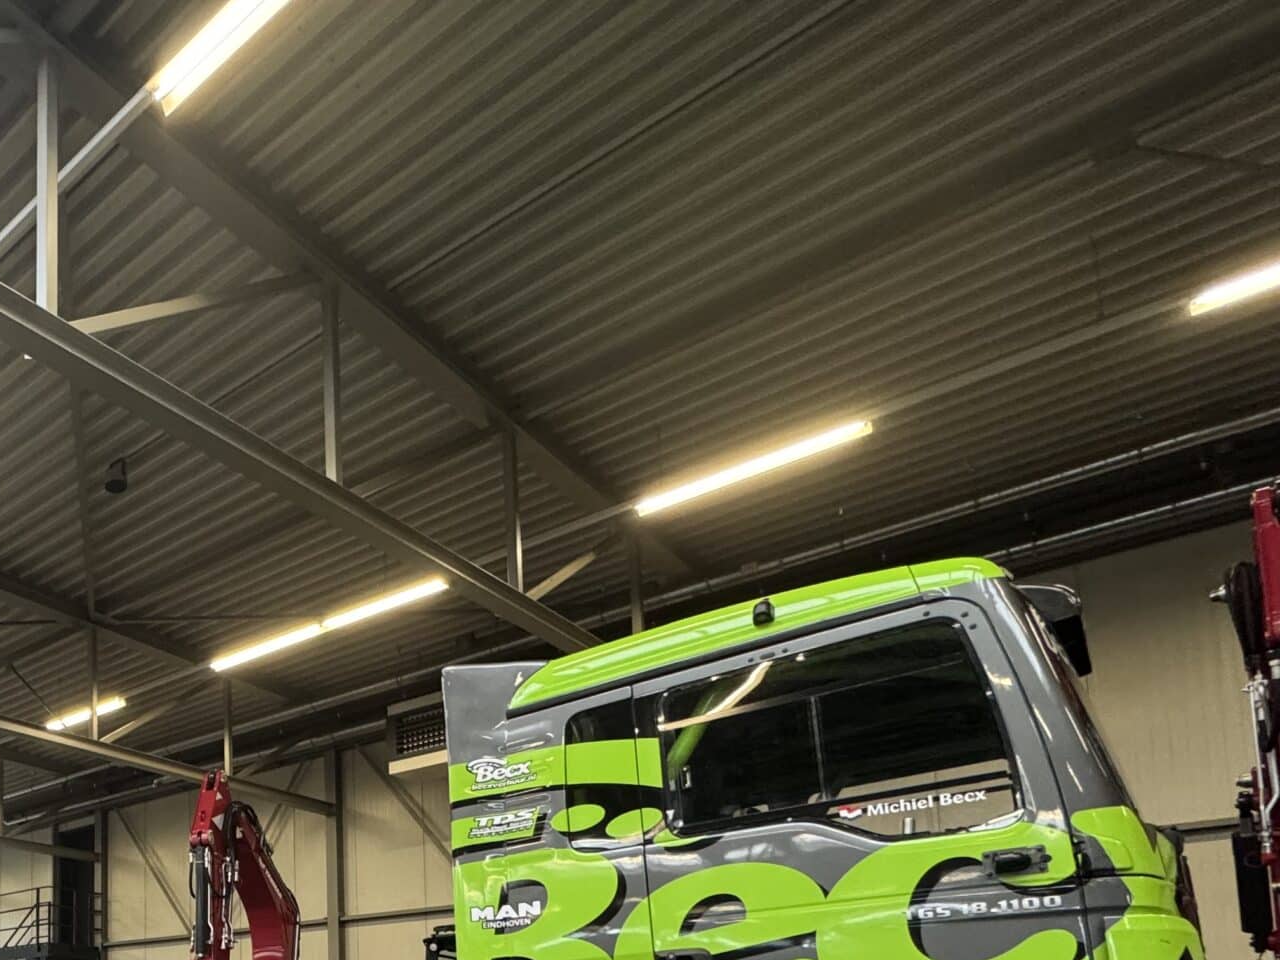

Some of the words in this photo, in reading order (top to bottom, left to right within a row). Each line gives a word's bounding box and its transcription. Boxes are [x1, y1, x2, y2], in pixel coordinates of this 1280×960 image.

[475, 762, 532, 783] Becx
[866, 795, 935, 817] Michiel
[938, 789, 988, 807] Becx
[471, 900, 541, 922] MAN
[482, 918, 532, 929] EINDHOVEN
